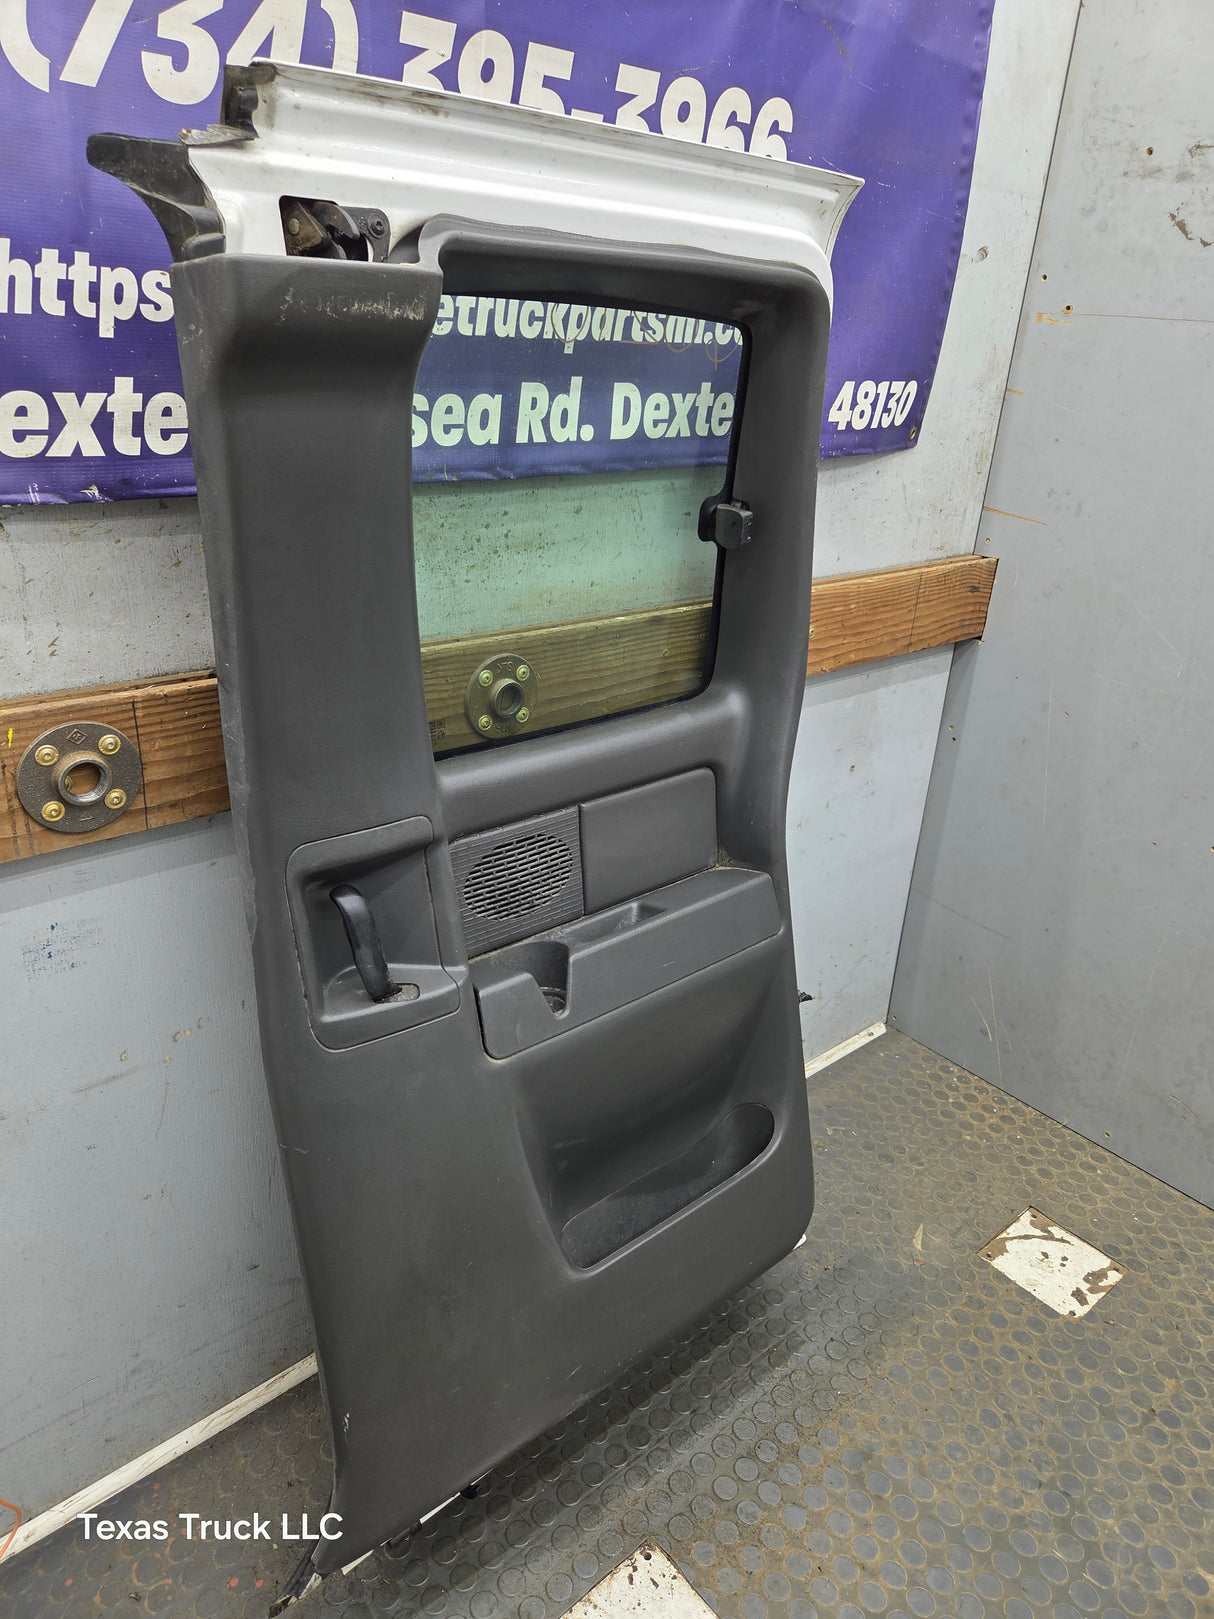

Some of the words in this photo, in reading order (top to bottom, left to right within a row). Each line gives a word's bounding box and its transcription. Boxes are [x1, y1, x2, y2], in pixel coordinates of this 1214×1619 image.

[0, 237, 175, 338] https
[0, 376, 189, 458] exte
[515, 376, 594, 444] Rd.
[610, 381, 735, 440] Dexte
[828, 380, 918, 430] 48130
